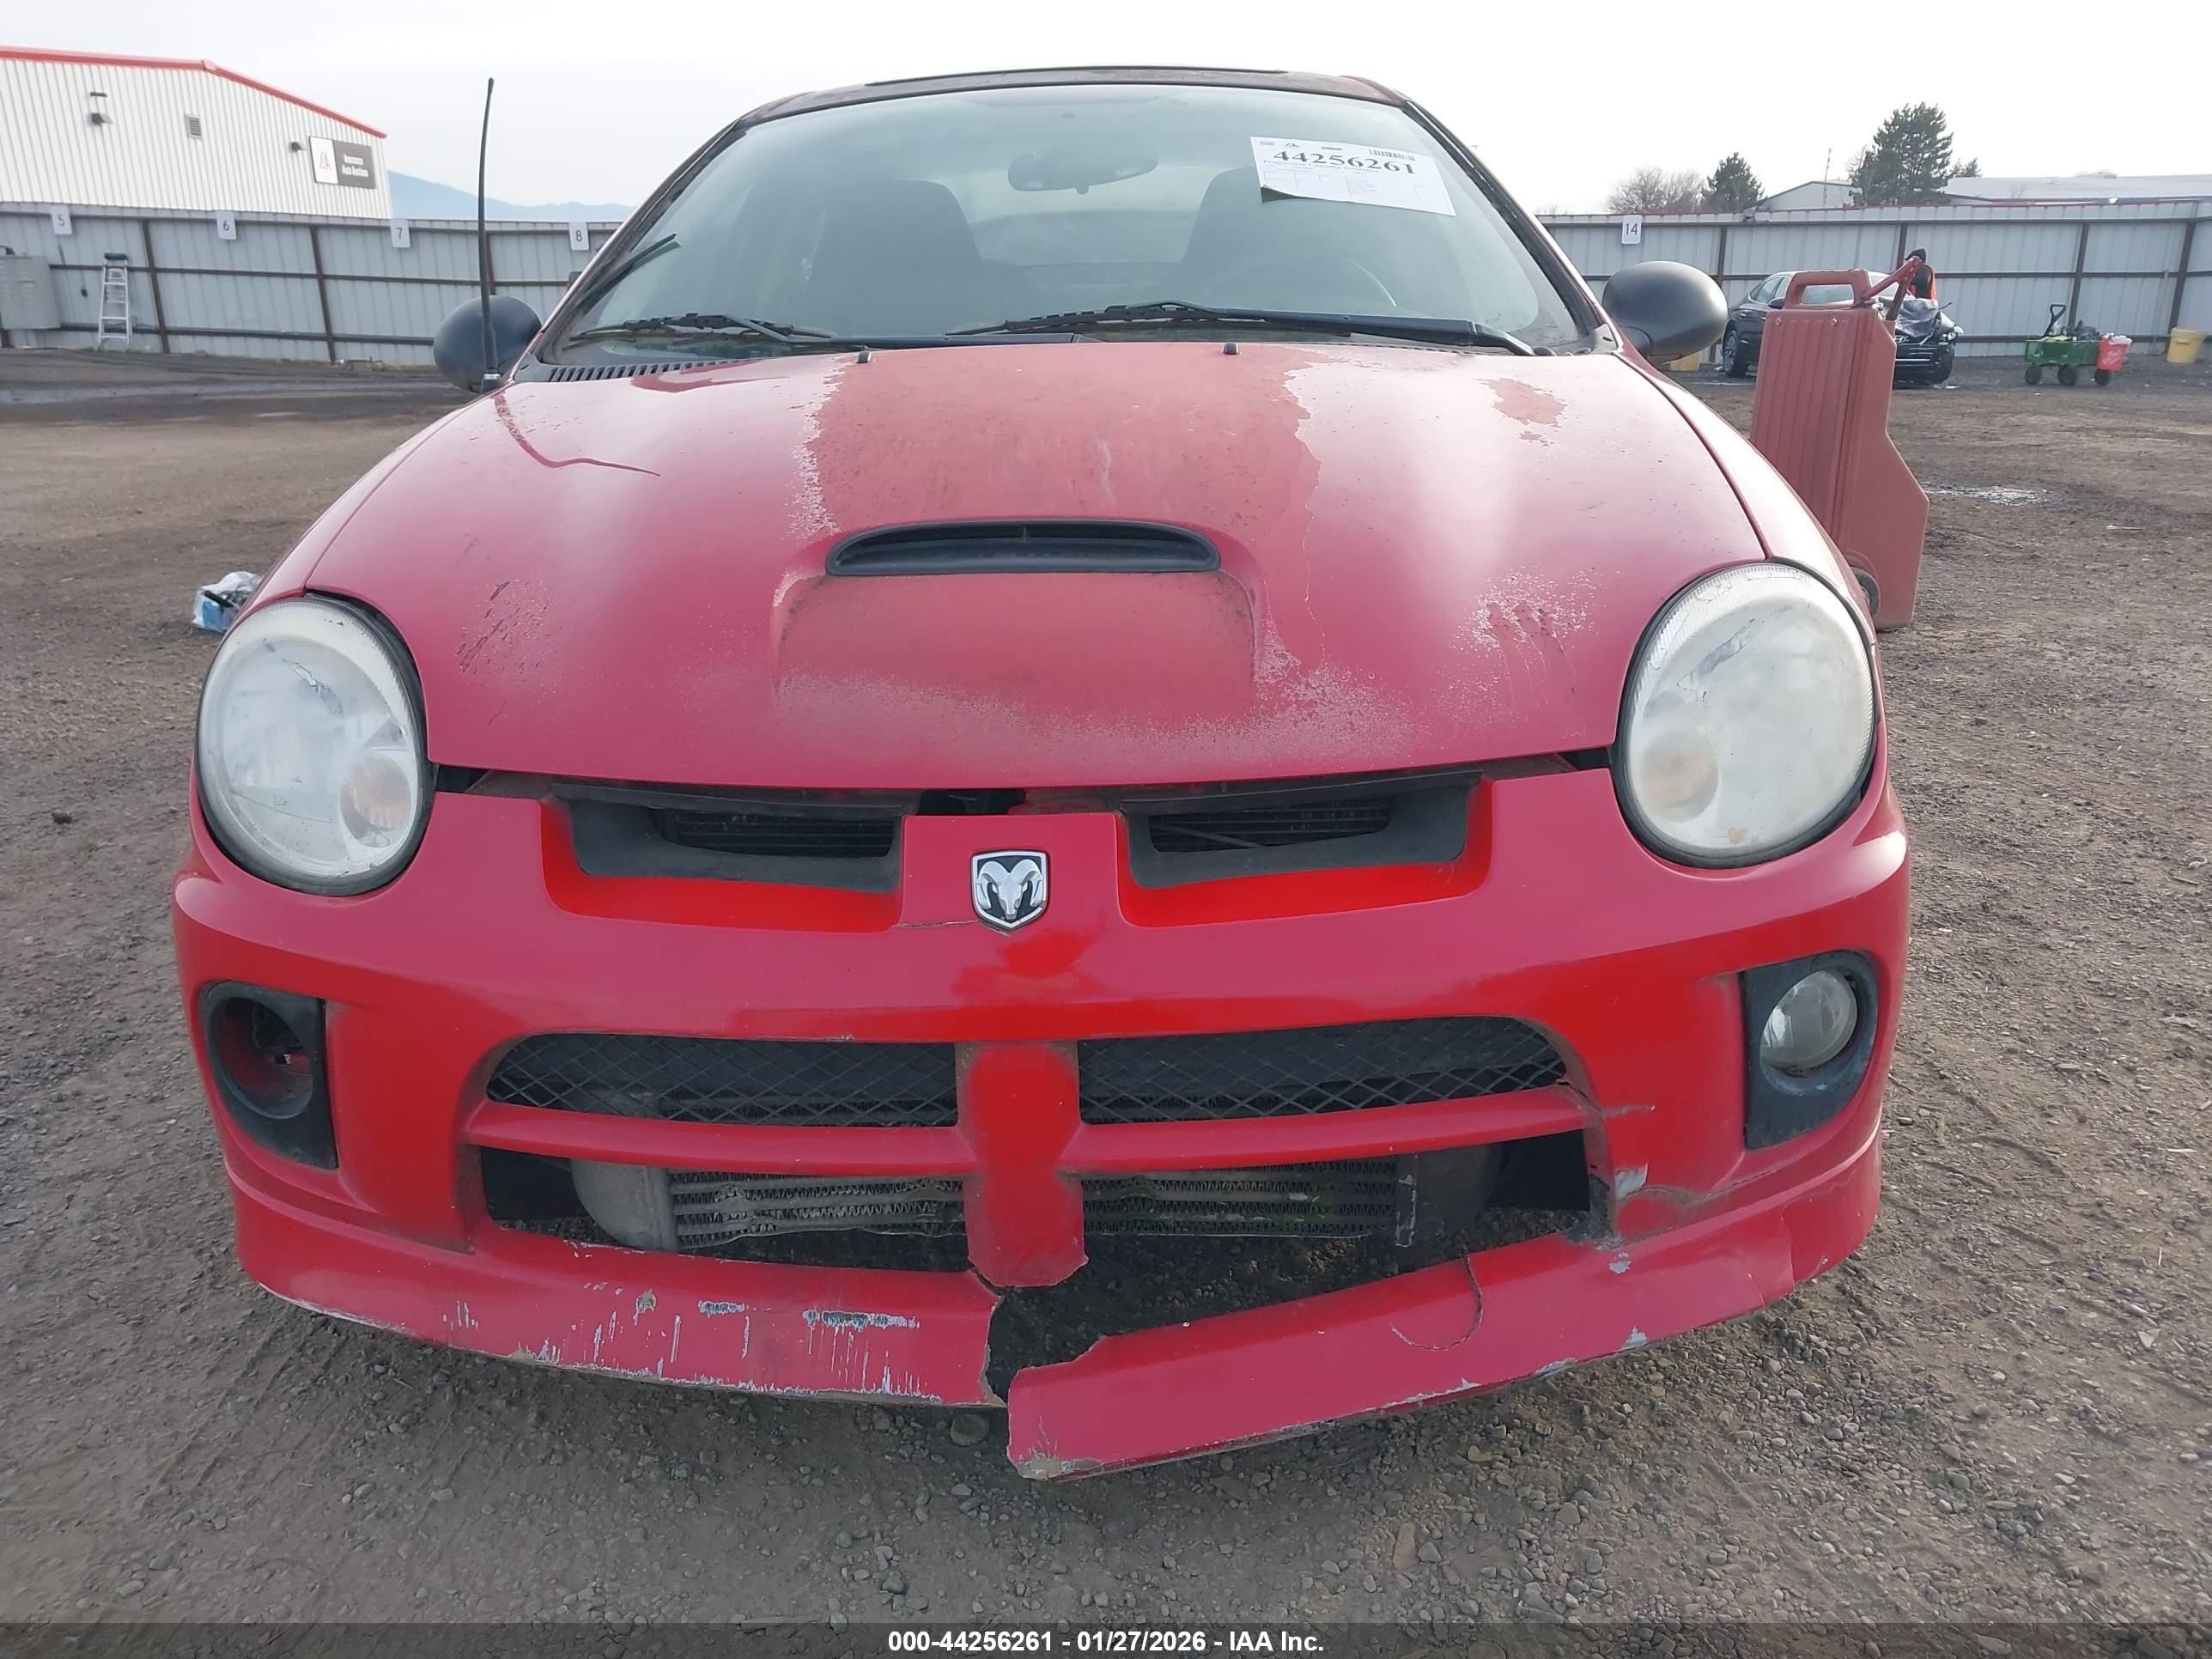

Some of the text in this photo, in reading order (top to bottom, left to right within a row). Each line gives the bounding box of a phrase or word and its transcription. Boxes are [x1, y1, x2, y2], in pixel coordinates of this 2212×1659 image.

[1273, 150, 1416, 174] 44256261
[57, 213, 65, 227] 5
[222, 219, 230, 231] 6
[396, 227, 404, 240] 7
[1626, 222, 1638, 235] 14
[575, 229, 583, 242] 8
